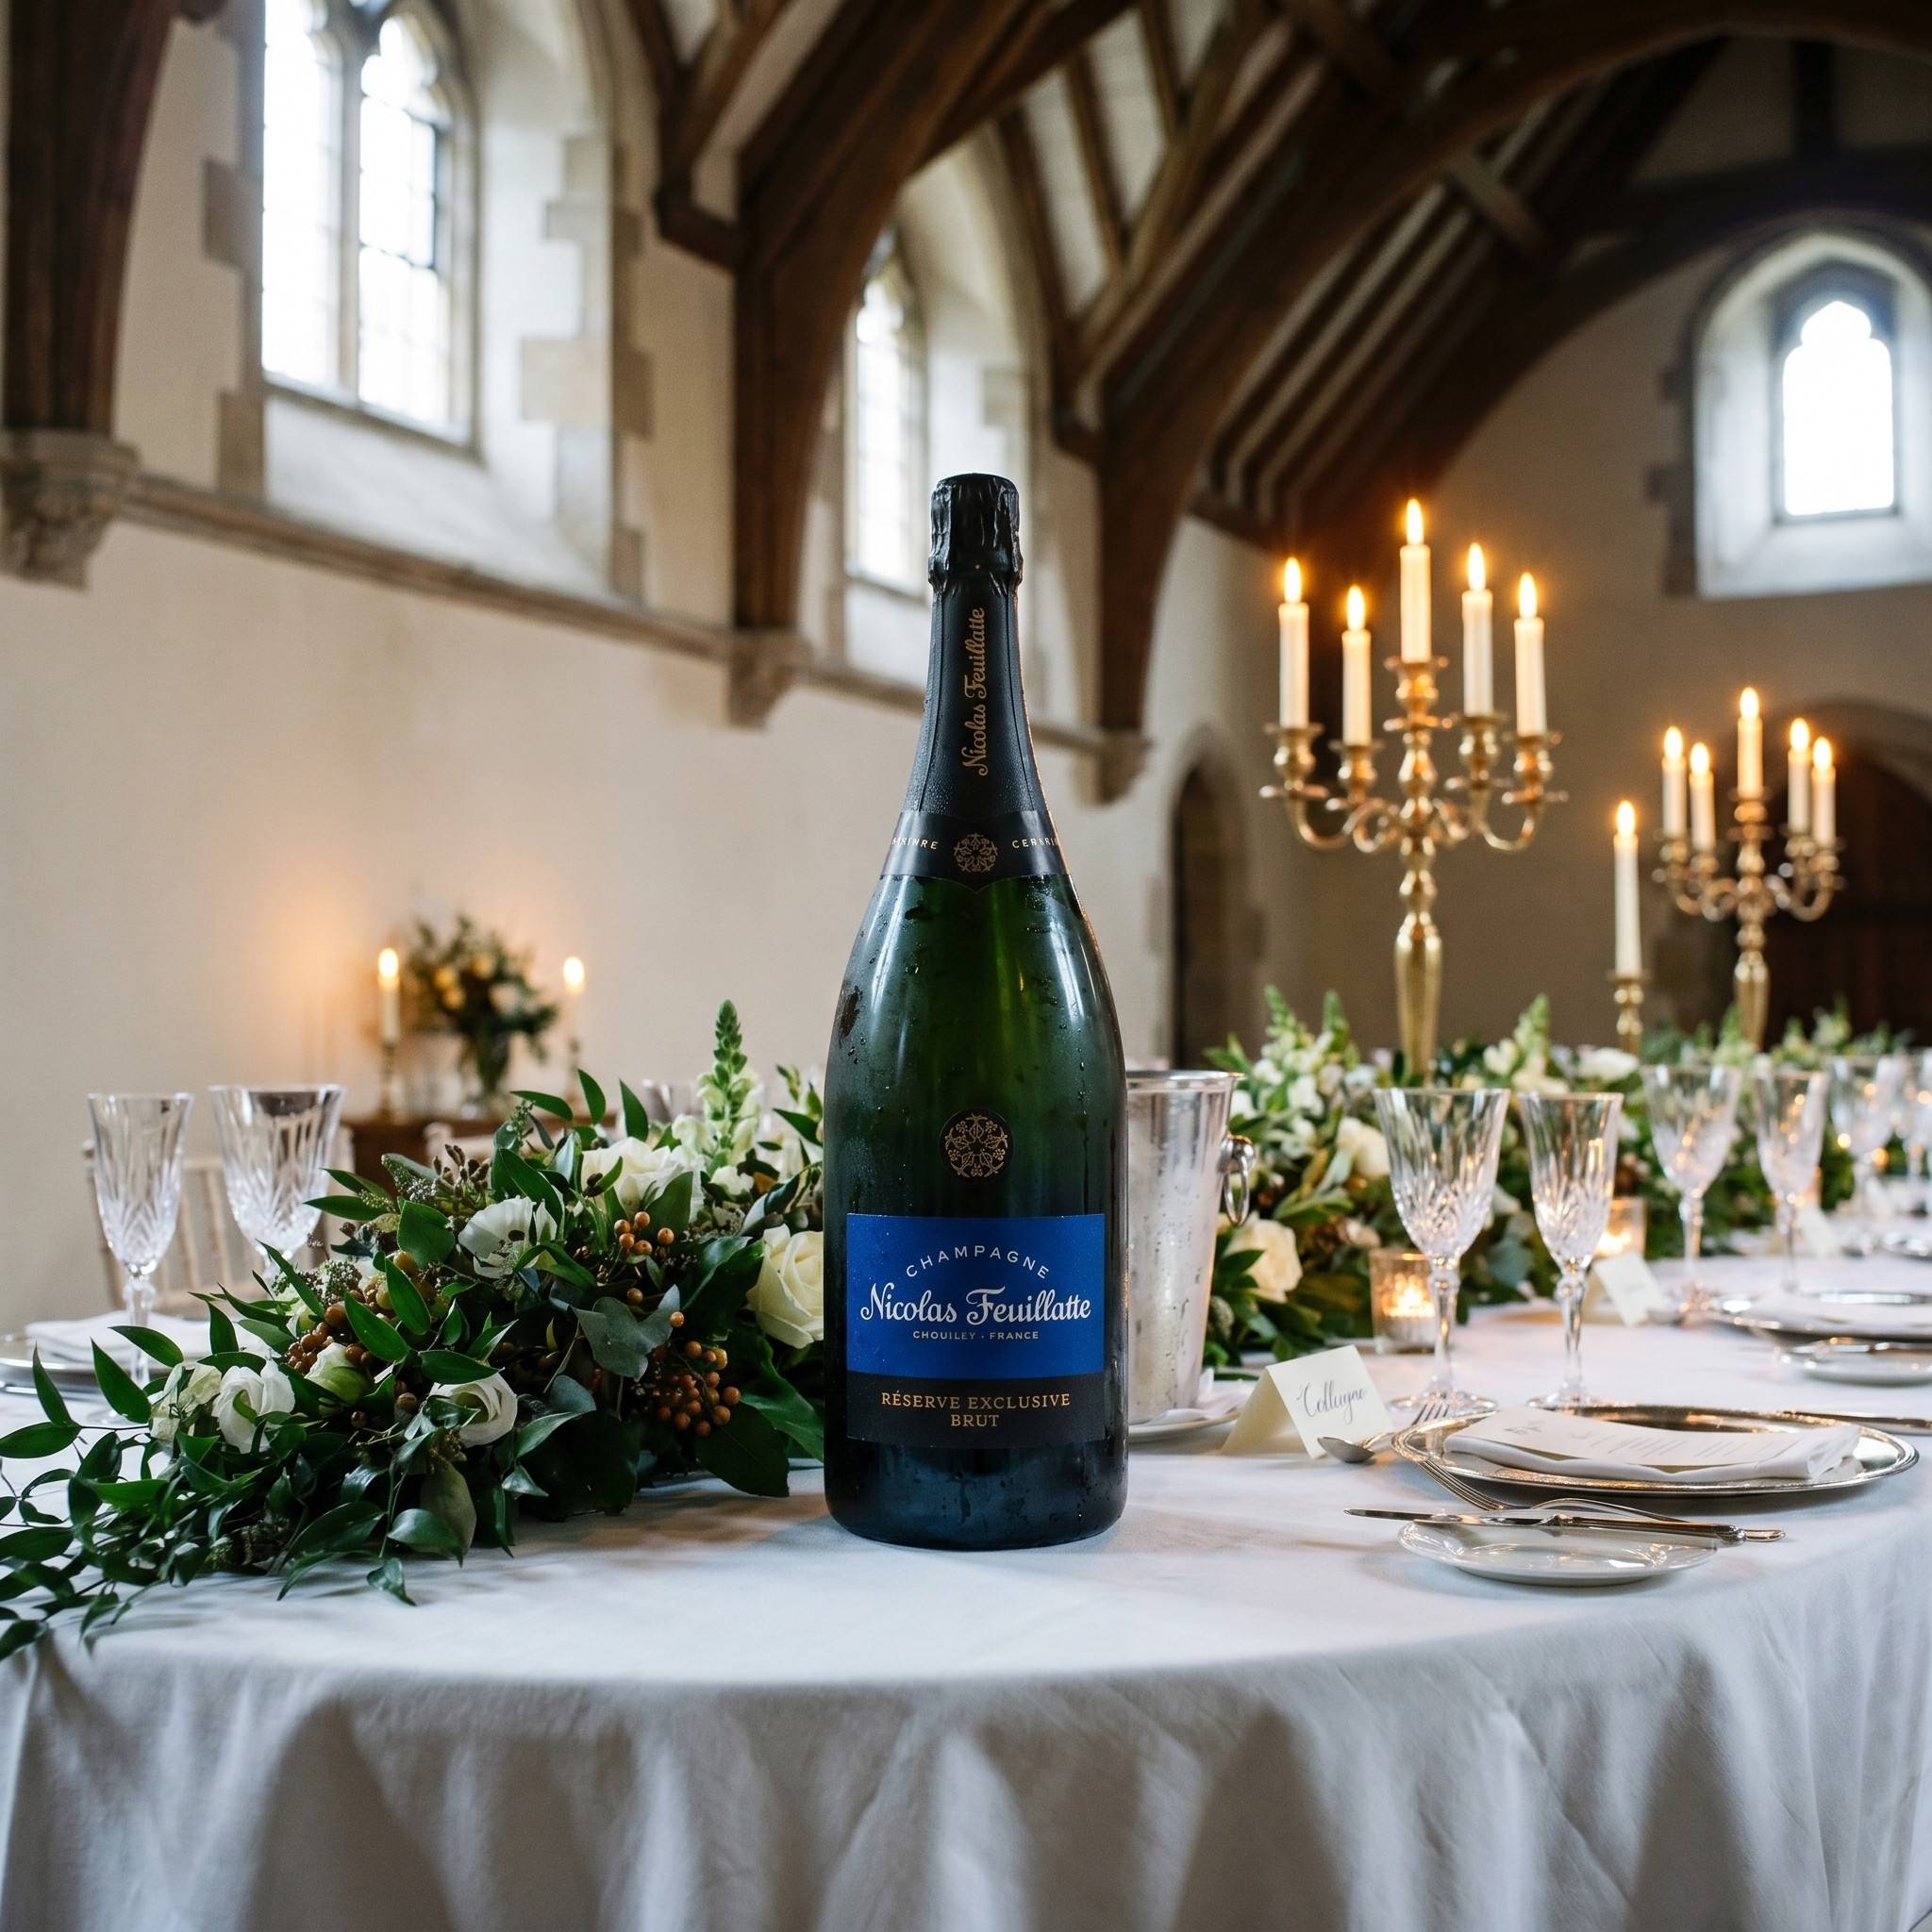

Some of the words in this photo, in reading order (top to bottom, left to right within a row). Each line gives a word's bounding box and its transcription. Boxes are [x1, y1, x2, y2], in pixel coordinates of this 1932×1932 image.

[964, 607, 988, 700] Feuillatte
[960, 704, 989, 776] Nicolas
[906, 1244, 1049, 1279] CHAMPAGNE
[859, 1282, 958, 1324] Nicolas
[966, 1286, 1091, 1325] Feuillatte
[990, 1331, 1040, 1340] FRANCE
[881, 1390, 960, 1409] RÉSERVE
[967, 1393, 1071, 1409] EXCLUSIVE
[950, 1414, 1000, 1427] BRUT
